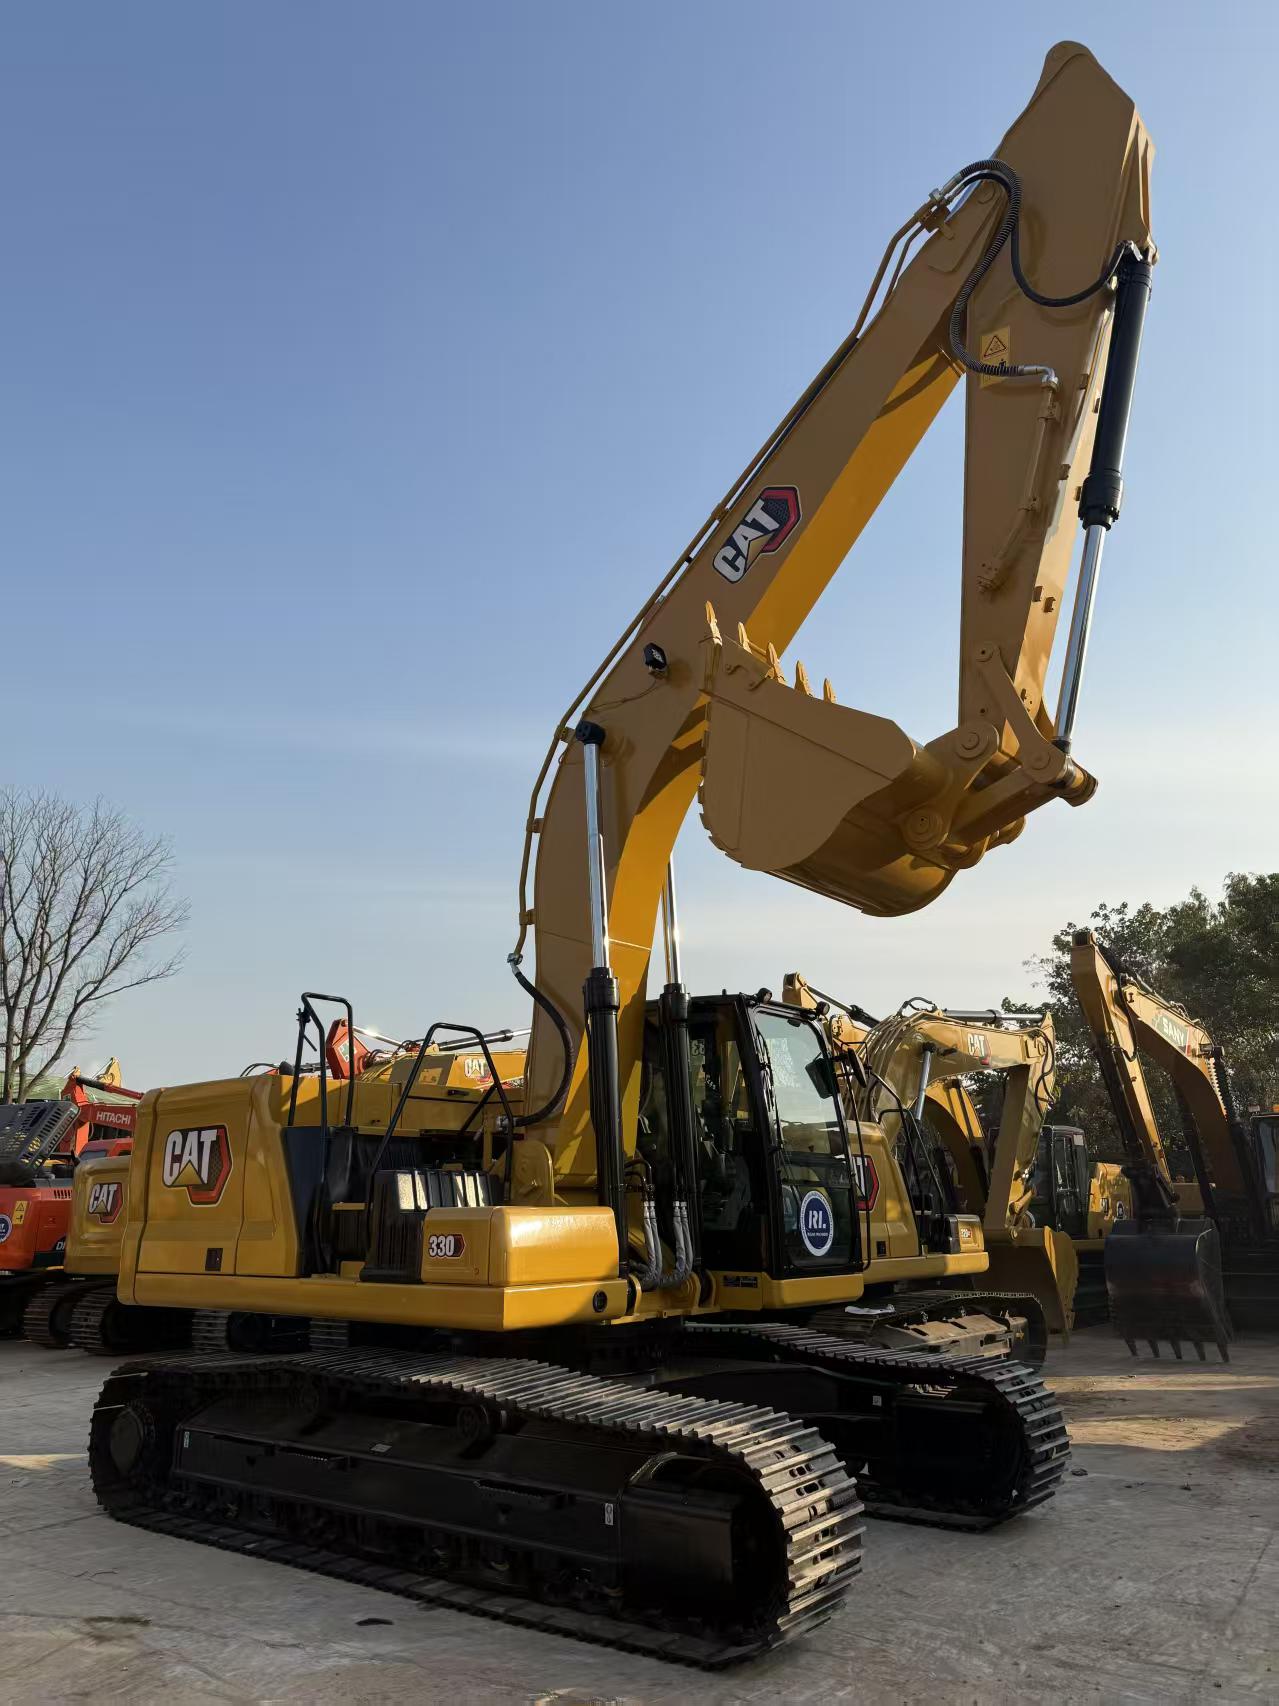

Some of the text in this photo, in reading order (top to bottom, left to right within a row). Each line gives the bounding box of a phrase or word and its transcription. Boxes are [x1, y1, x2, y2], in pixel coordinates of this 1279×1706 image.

[713, 499, 780, 582] CAT
[967, 1033, 985, 1057] CAT
[1162, 1016, 1184, 1047] SANY
[464, 1058, 487, 1077] CAT
[96, 1111, 131, 1125] HITACHI
[163, 1129, 218, 1186] CAT
[89, 1183, 118, 1213] CAT
[429, 1235, 455, 1257] 330
